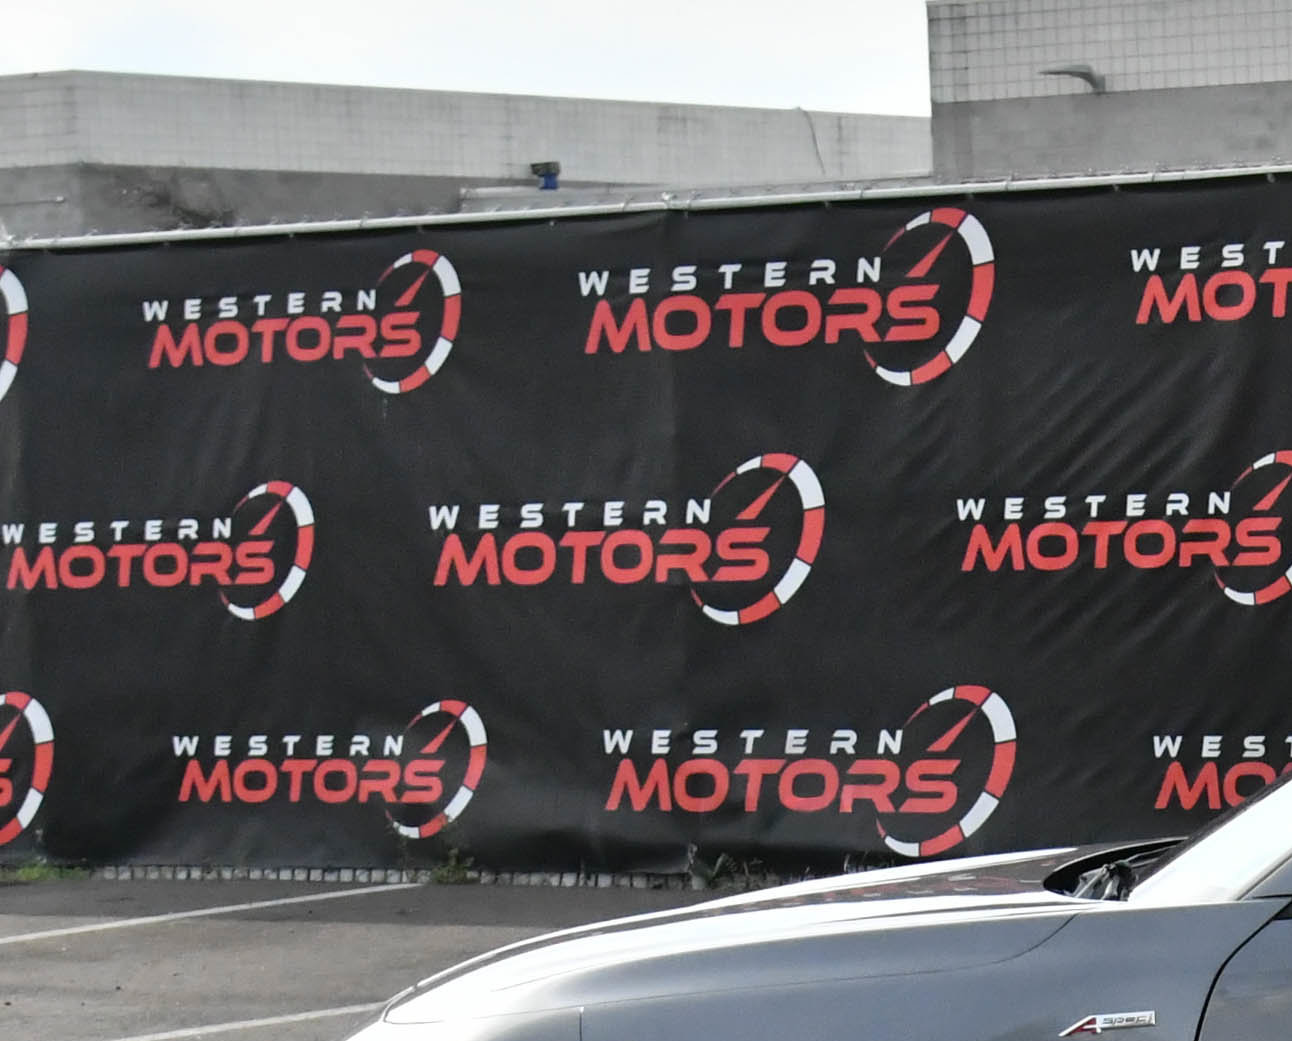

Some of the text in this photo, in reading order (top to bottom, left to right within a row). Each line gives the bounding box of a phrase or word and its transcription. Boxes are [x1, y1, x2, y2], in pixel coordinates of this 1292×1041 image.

[578, 256, 881, 297] WESTERN
[143, 289, 376, 322] WESTERN
[585, 283, 941, 355] MOTORS
[148, 311, 422, 369] MOTORS
[428, 498, 711, 531] WESTERN
[956, 491, 1231, 521] WESTERN
[1, 517, 232, 545] WESTERN
[961, 516, 1283, 572] MOTORS
[7, 540, 275, 590] MOTORS
[433, 527, 771, 587] MOTORS
[173, 735, 404, 757] WESTERN
[603, 729, 903, 755] WESTERN
[178, 758, 444, 804] MOTORS
[605, 757, 961, 814] MOTORS
